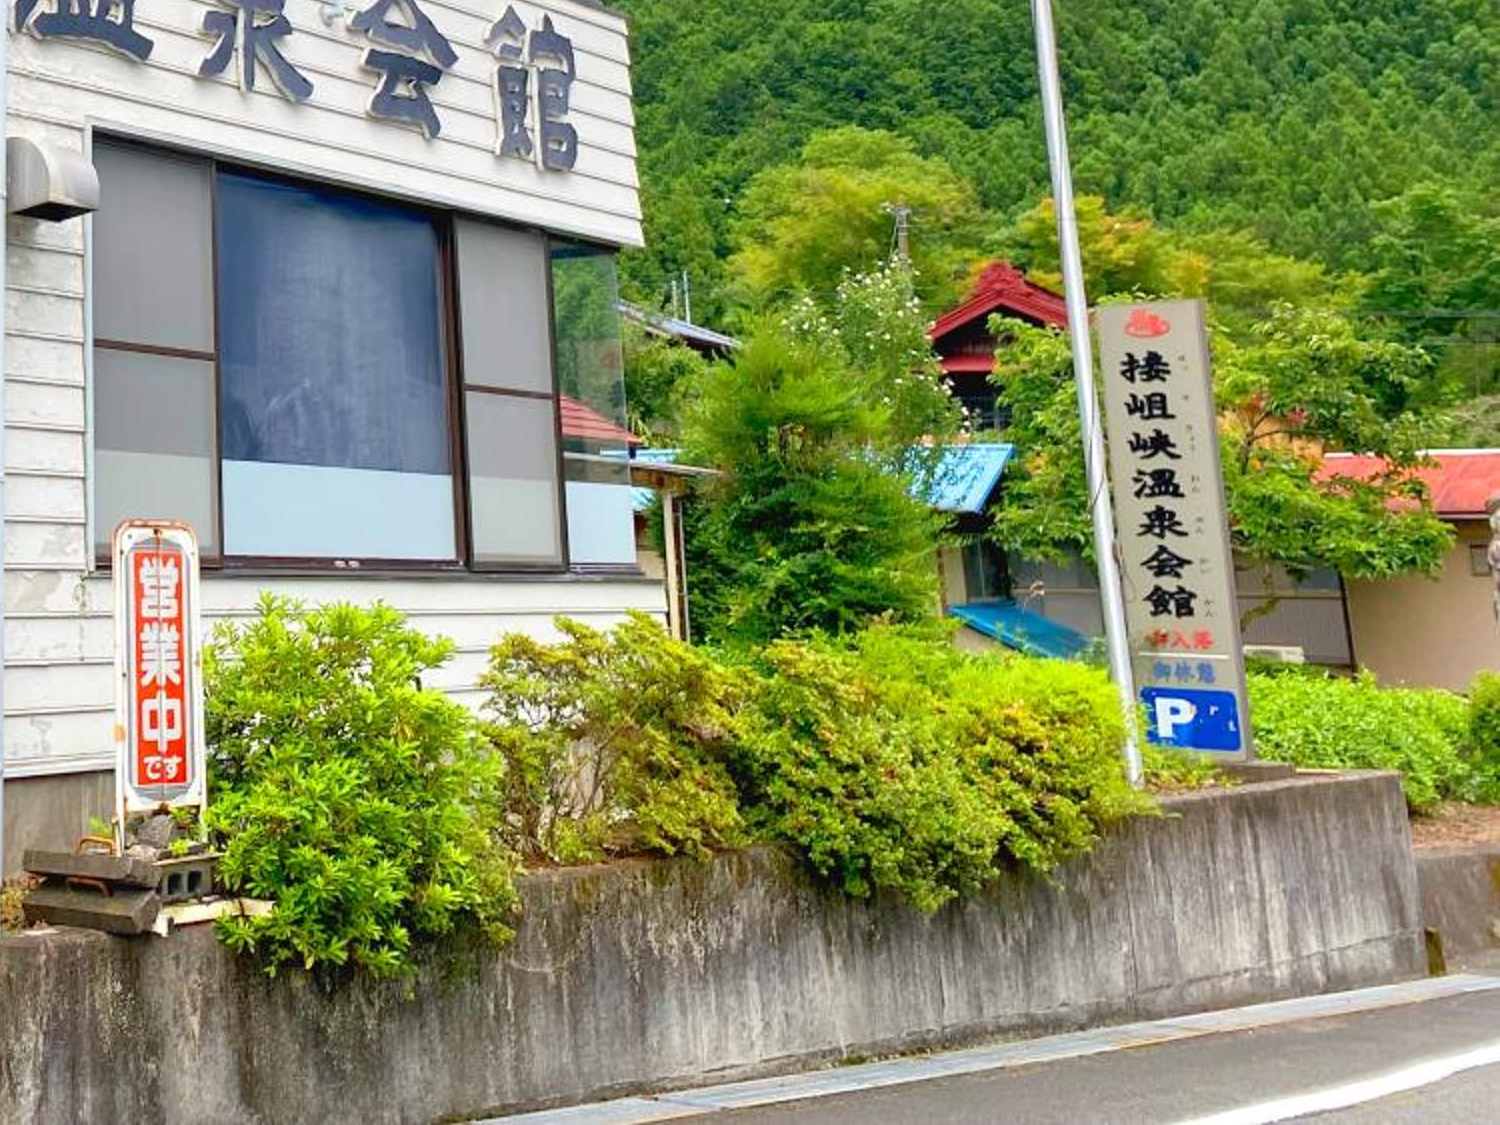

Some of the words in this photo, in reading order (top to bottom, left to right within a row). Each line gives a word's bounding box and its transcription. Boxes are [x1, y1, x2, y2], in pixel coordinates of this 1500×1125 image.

[1120, 351, 1197, 618] 接岨峡温泉会館
[1154, 696, 1197, 738] P
